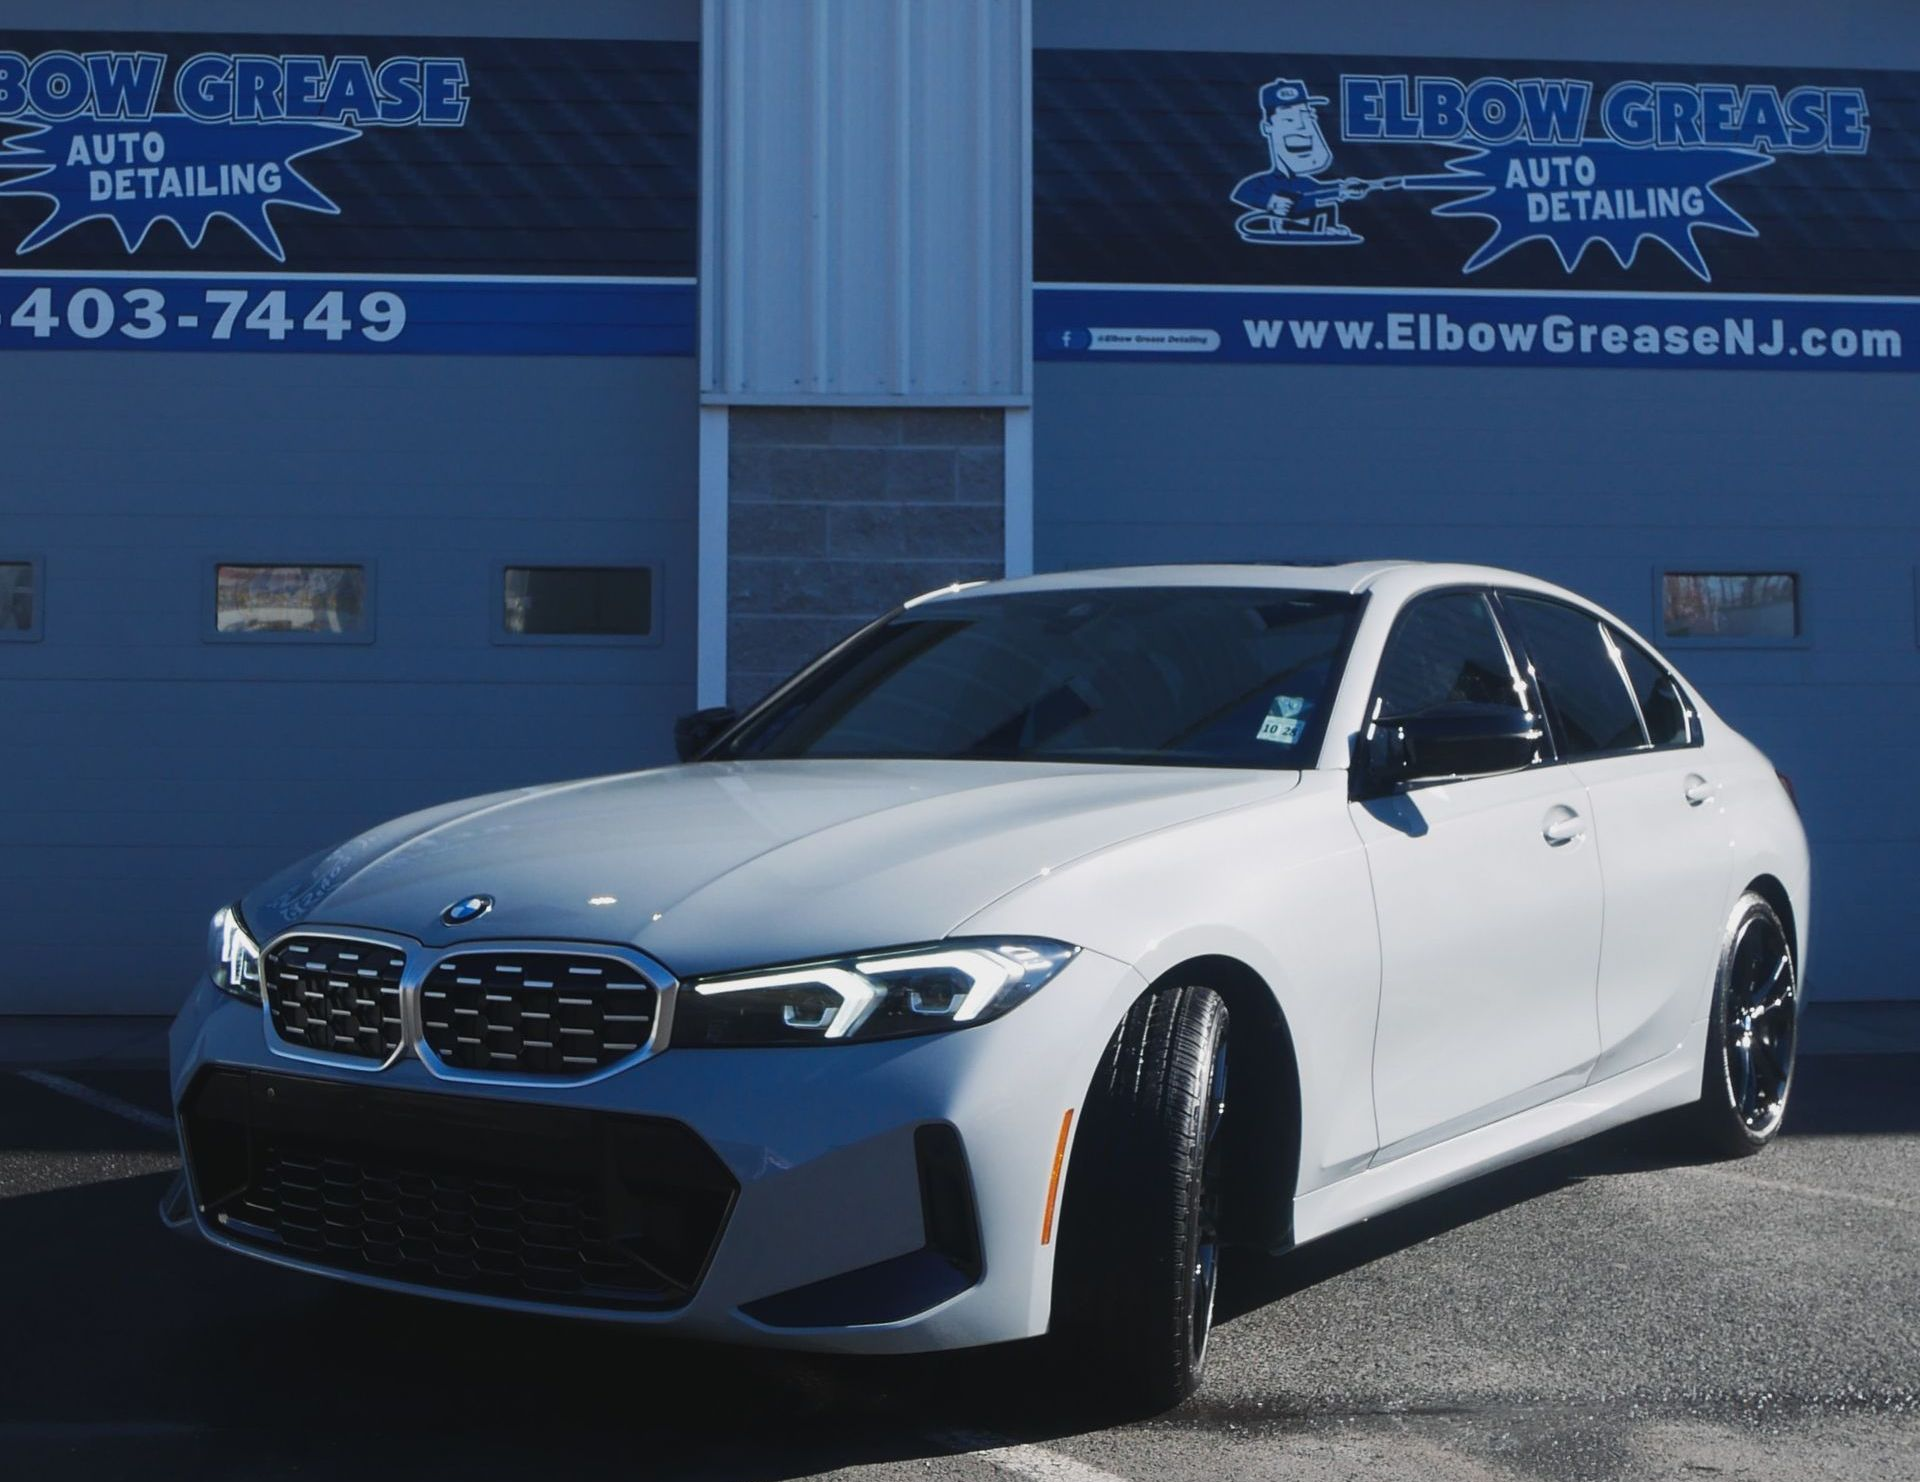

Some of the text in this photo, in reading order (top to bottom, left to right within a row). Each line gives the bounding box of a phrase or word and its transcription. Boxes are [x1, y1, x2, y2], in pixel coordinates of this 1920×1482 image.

[175, 54, 470, 125] GREASE
[1340, 74, 1870, 154] ELBOW GREASE
[66, 131, 164, 166] AUTO
[89, 162, 282, 201] DETAILING
[1505, 155, 1596, 188] AUTO
[1526, 186, 1706, 223] DETAILING
[0, 287, 406, 342] 403-7449
[1134, 334, 1166, 343] Grease
[1167, 335, 1208, 345] Detailing
[1243, 313, 1904, 360] www.ElbowGreaseNJ.com
[1264, 724, 1278, 734] 10
